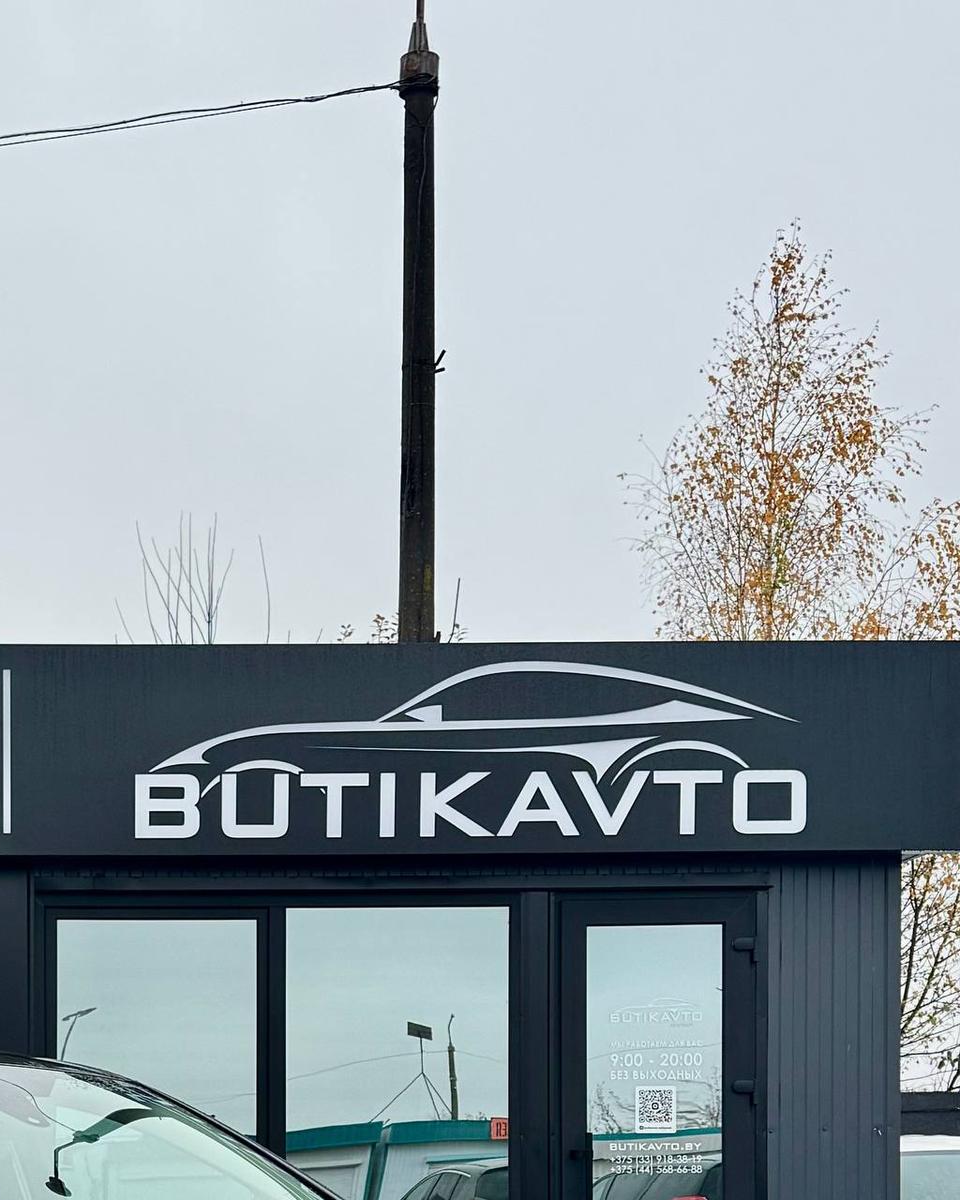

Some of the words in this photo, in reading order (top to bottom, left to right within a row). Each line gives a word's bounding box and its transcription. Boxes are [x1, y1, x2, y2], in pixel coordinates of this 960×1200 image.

[134, 768, 808, 839] BUTIKAVTO
[610, 1011, 703, 1023] BUTIKAVTO
[610, 1053, 643, 1067] 9:00
[660, 1053, 703, 1067] 20:00
[610, 1070, 629, 1080] БЕЗ
[632, 1070, 703, 1080] ВЫХОДНЫХ
[609, 1142, 702, 1151] BUTIKAVTO.BY
[610, 1154, 633, 1164] +375
[635, 1154, 654, 1166] (33)
[656, 1154, 703, 1164] 918-38-19
[610, 1165, 633, 1174] +375
[635, 1165, 654, 1176] (44)
[656, 1165, 703, 1174] 568-66-88
